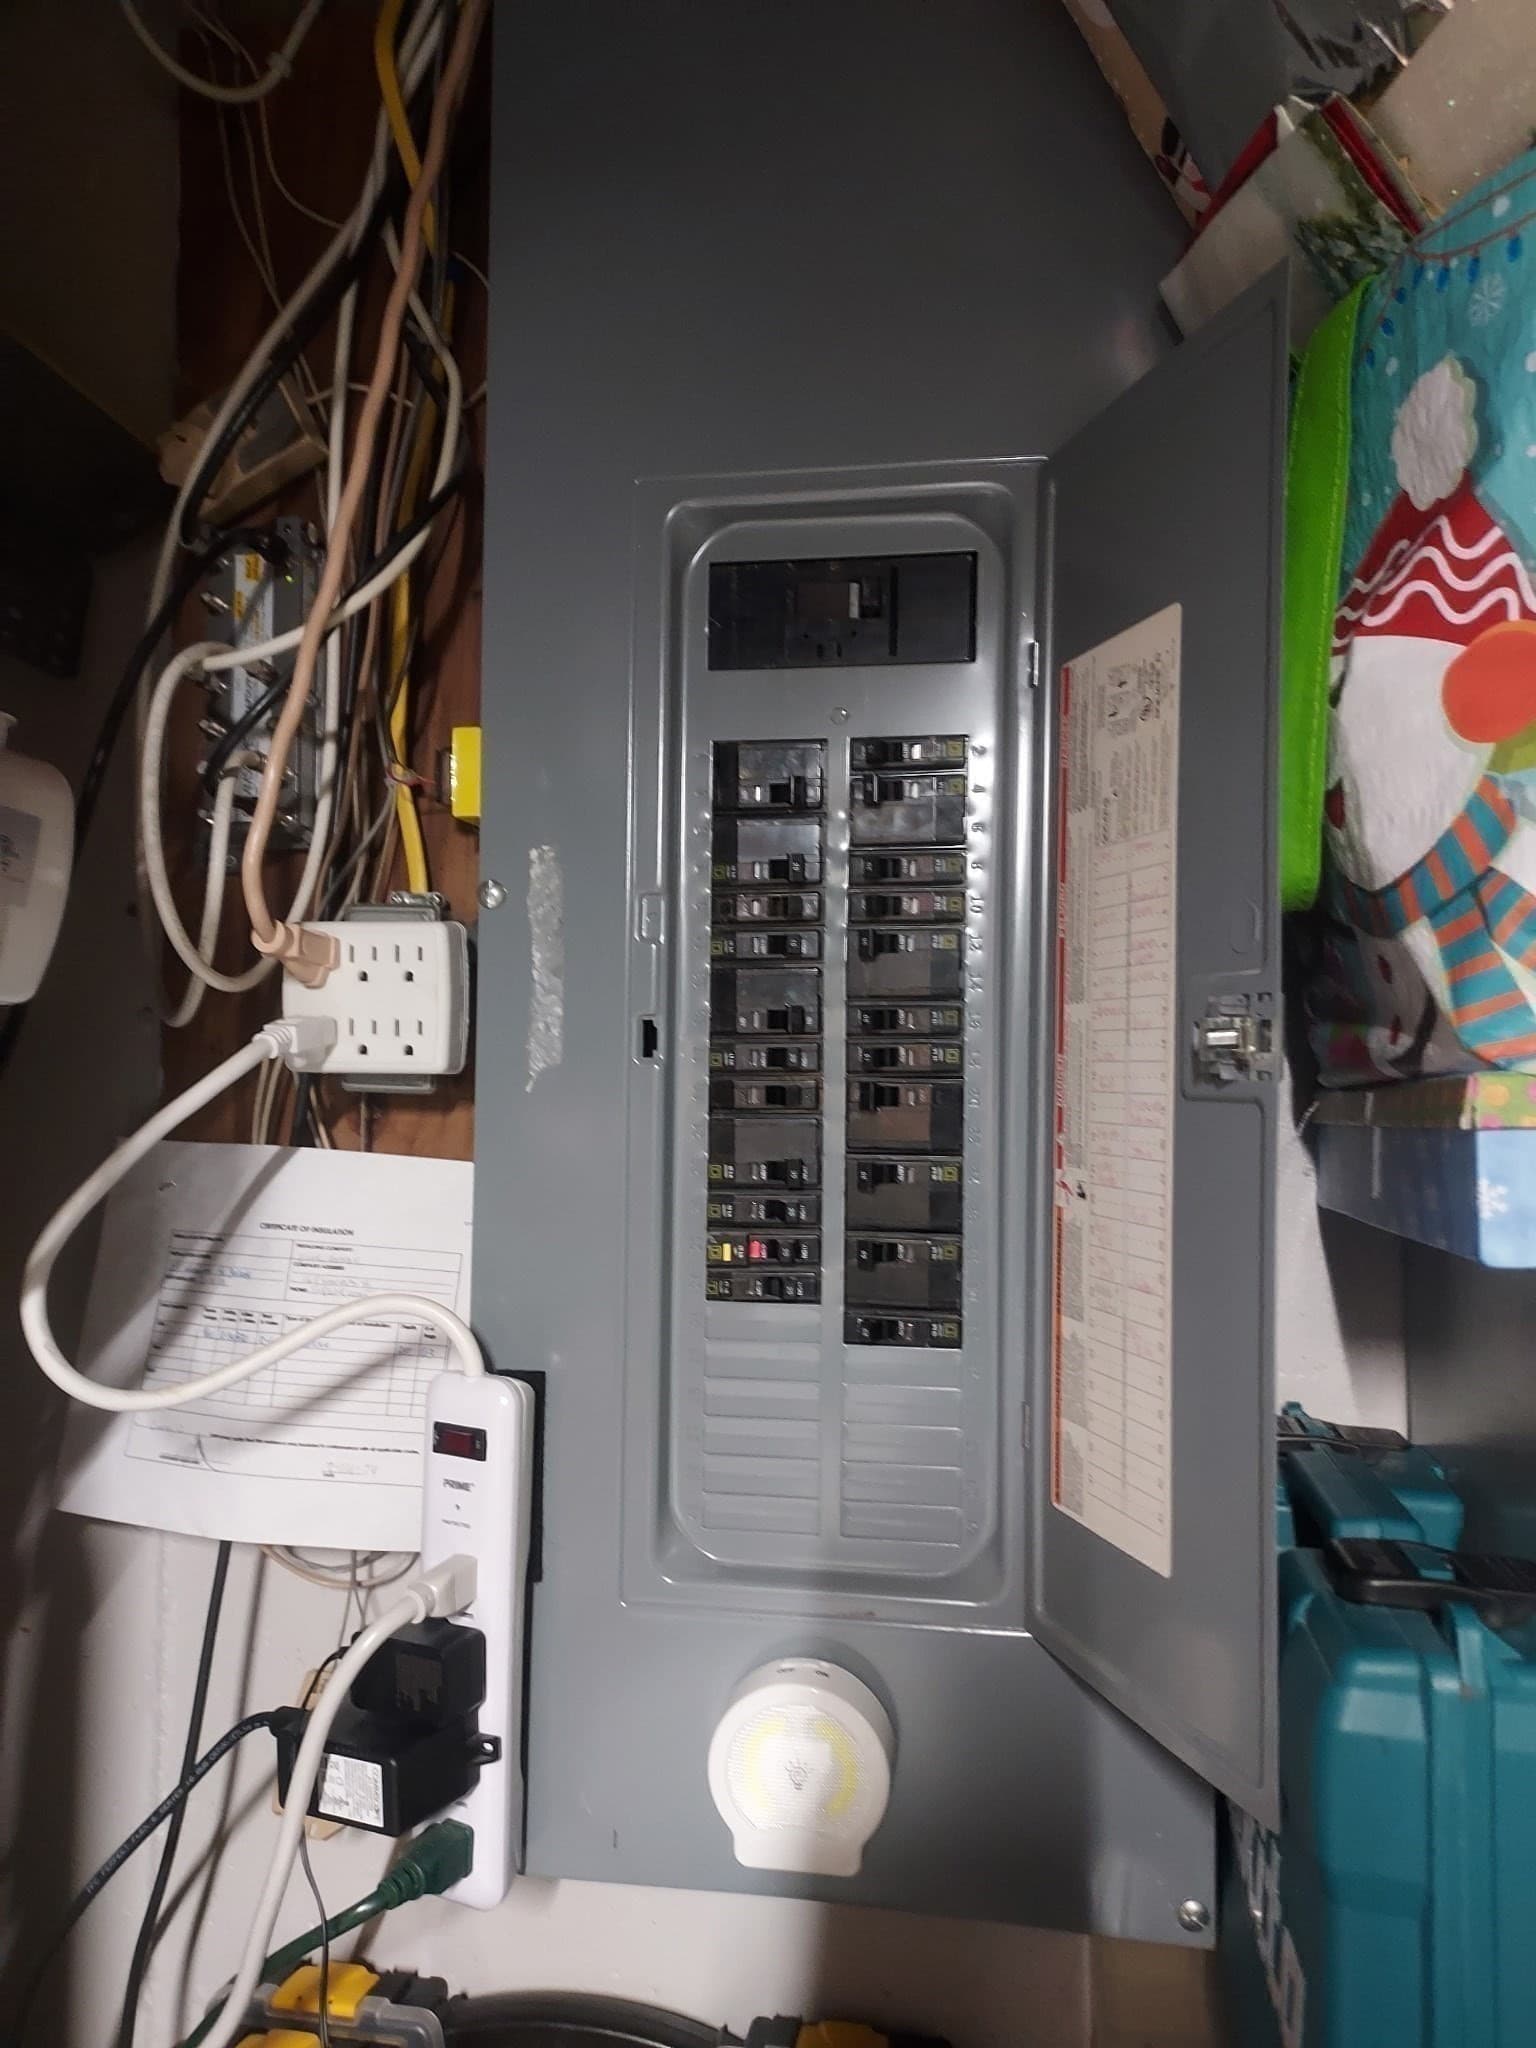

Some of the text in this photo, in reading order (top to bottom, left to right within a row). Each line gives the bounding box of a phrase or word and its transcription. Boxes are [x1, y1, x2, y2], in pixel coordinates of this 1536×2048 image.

[971, 784, 987, 794] 4
[970, 896, 984, 914] 10
[969, 935, 983, 954] 12
[259, 1222, 297, 1231] CERTIFICATE
[311, 1227, 354, 1235] INSULATION
